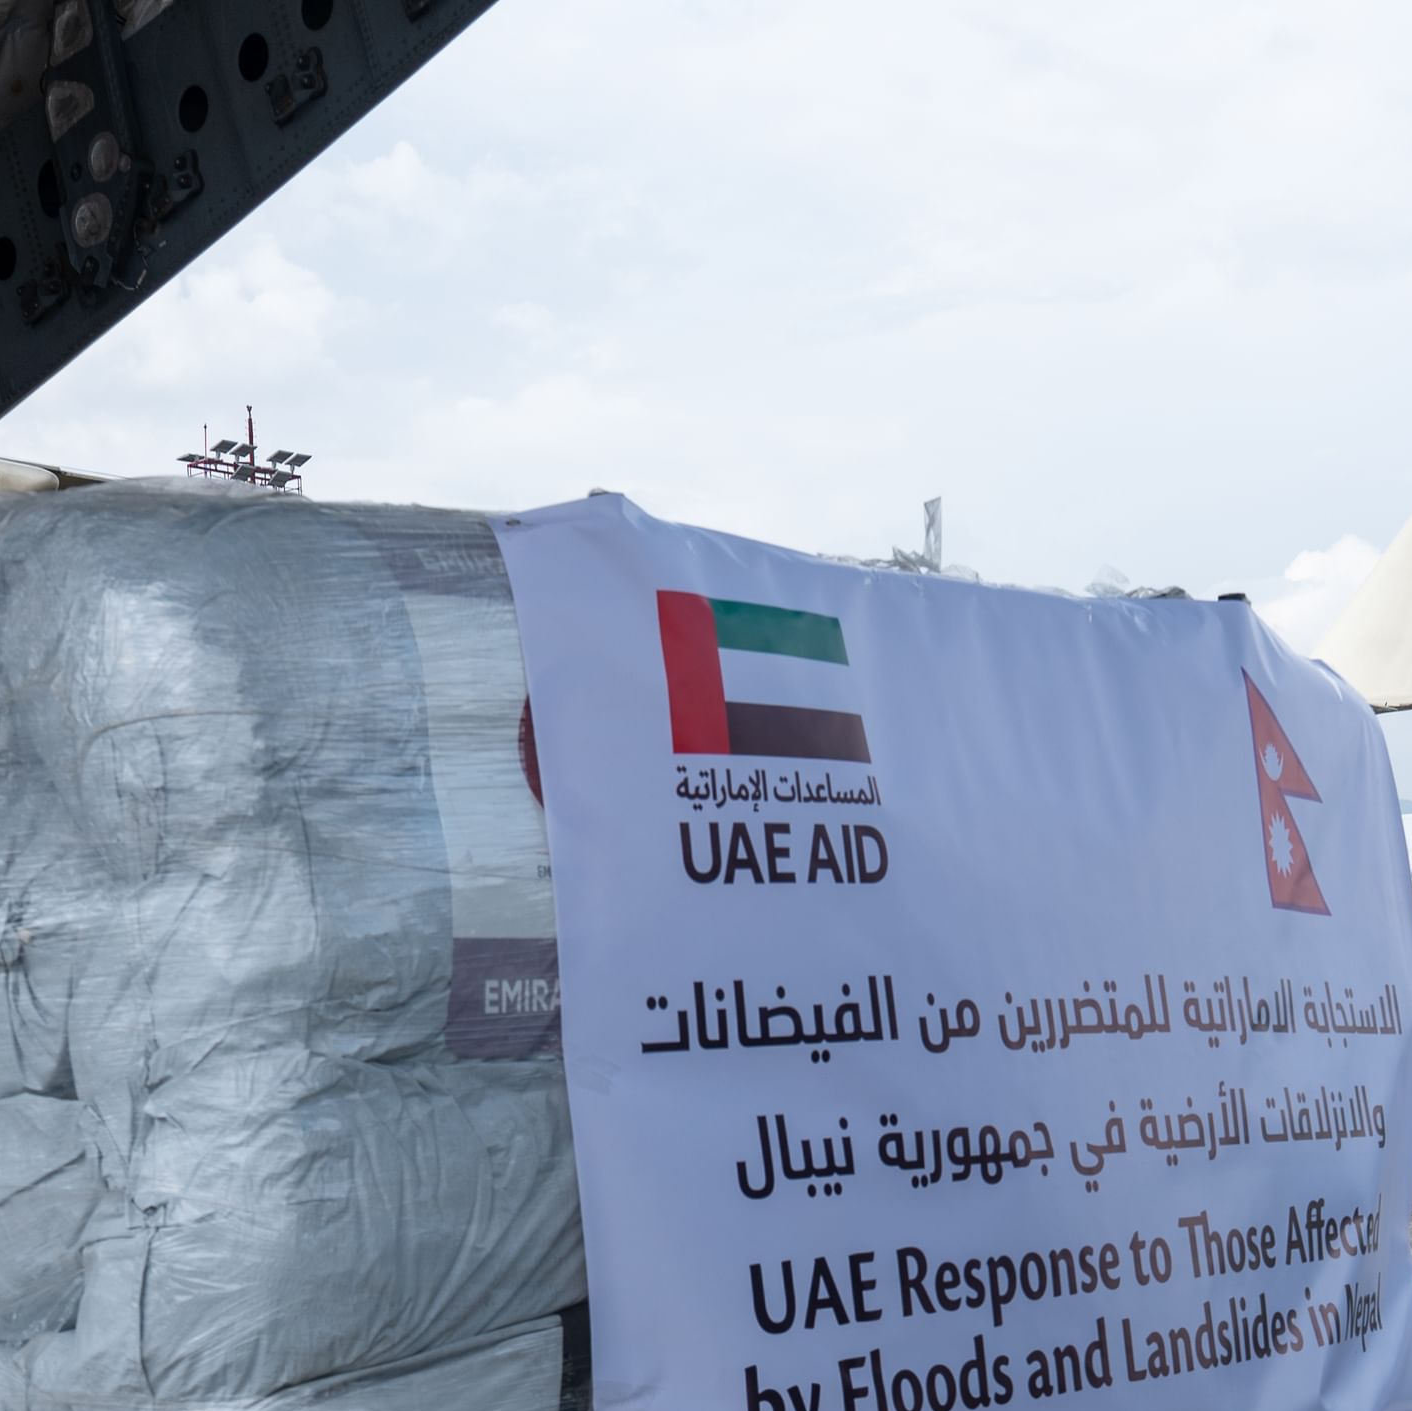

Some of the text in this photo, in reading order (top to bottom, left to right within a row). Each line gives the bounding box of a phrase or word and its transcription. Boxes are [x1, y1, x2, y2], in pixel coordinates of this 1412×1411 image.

[676, 766, 881, 813] المساعدات الإماراتية
[679, 822, 889, 885] UAE AID
[485, 978, 560, 1014] EMIRA
[641, 975, 899, 1064] الفيضانات
[919, 993, 980, 1054] من
[998, 974, 1171, 1053] للمتضررين
[1304, 979, 1403, 1048] الاستجابة
[736, 1081, 1386, 1200] والانزلاقات الأرضية في جمهورية نيبال
[749, 1193, 1382, 1335] UAE Response to Those Affected
[1026, 1316, 1113, 1400] and
[1122, 1292, 1304, 1383] Landslides
[1305, 1286, 1341, 1347] in
[1344, 1271, 1382, 1353] Nepal
